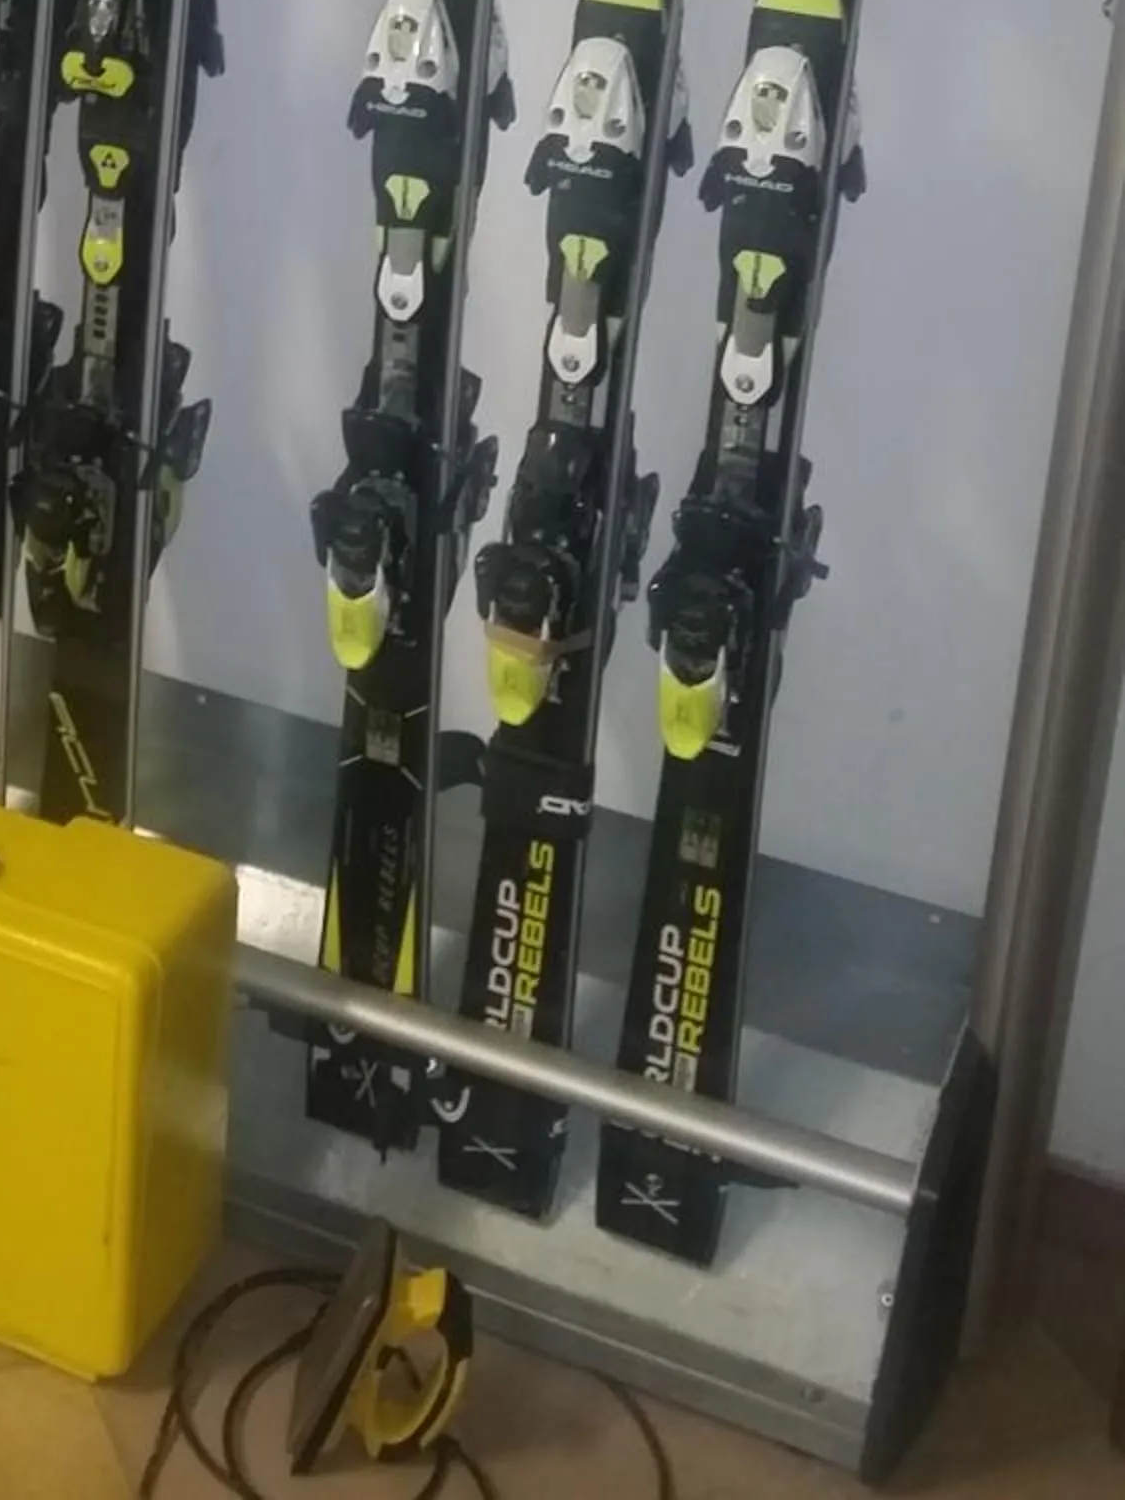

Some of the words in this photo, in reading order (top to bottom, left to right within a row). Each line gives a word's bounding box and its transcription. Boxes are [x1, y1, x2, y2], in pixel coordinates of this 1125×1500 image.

[513, 840, 556, 1005] REBELS
[644, 923, 684, 1084] RLDCUP
[677, 884, 722, 1054] REBELS
